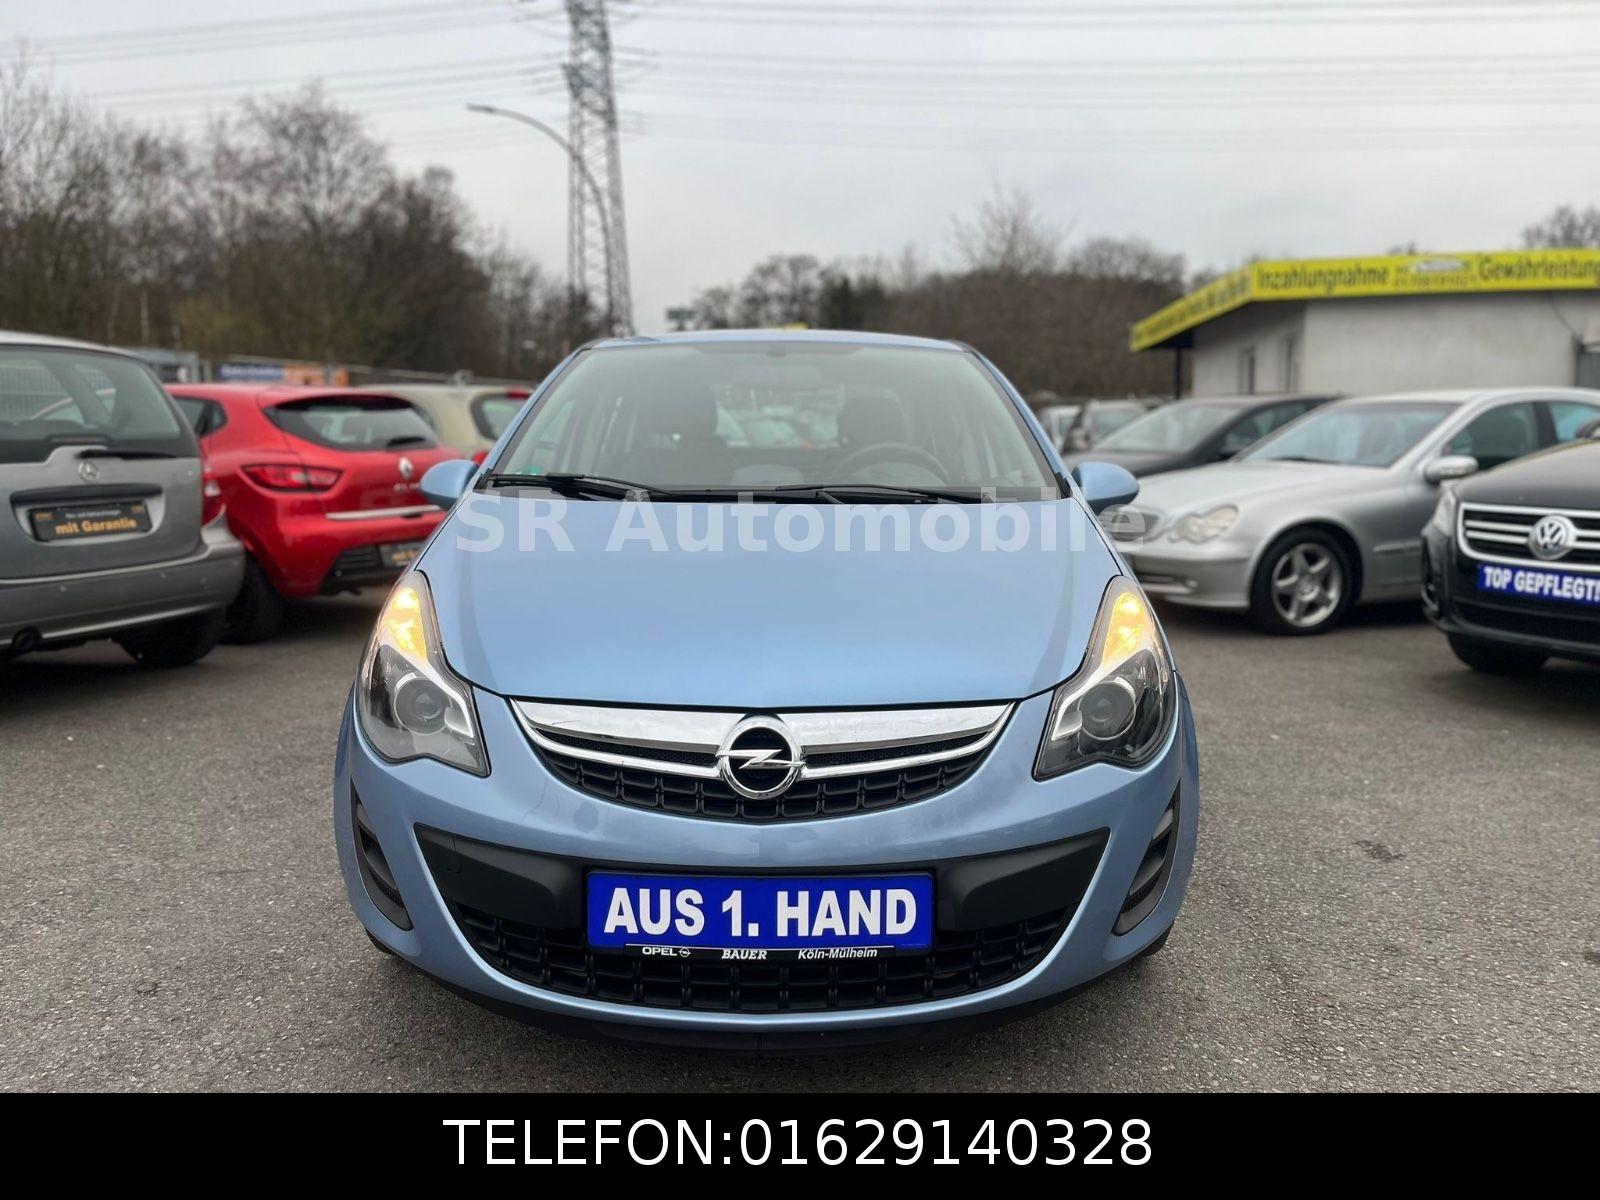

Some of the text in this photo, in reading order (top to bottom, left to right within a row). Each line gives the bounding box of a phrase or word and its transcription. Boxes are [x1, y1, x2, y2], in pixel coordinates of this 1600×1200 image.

[1479, 252, 1600, 281] Gewährleistun
[55, 517, 137, 534] mit Garantie
[1483, 566, 1512, 589] TOP
[604, 888, 917, 937] AUS 1. HAND
[642, 946, 878, 960] OPEL BAUER Köln-Mülheim
